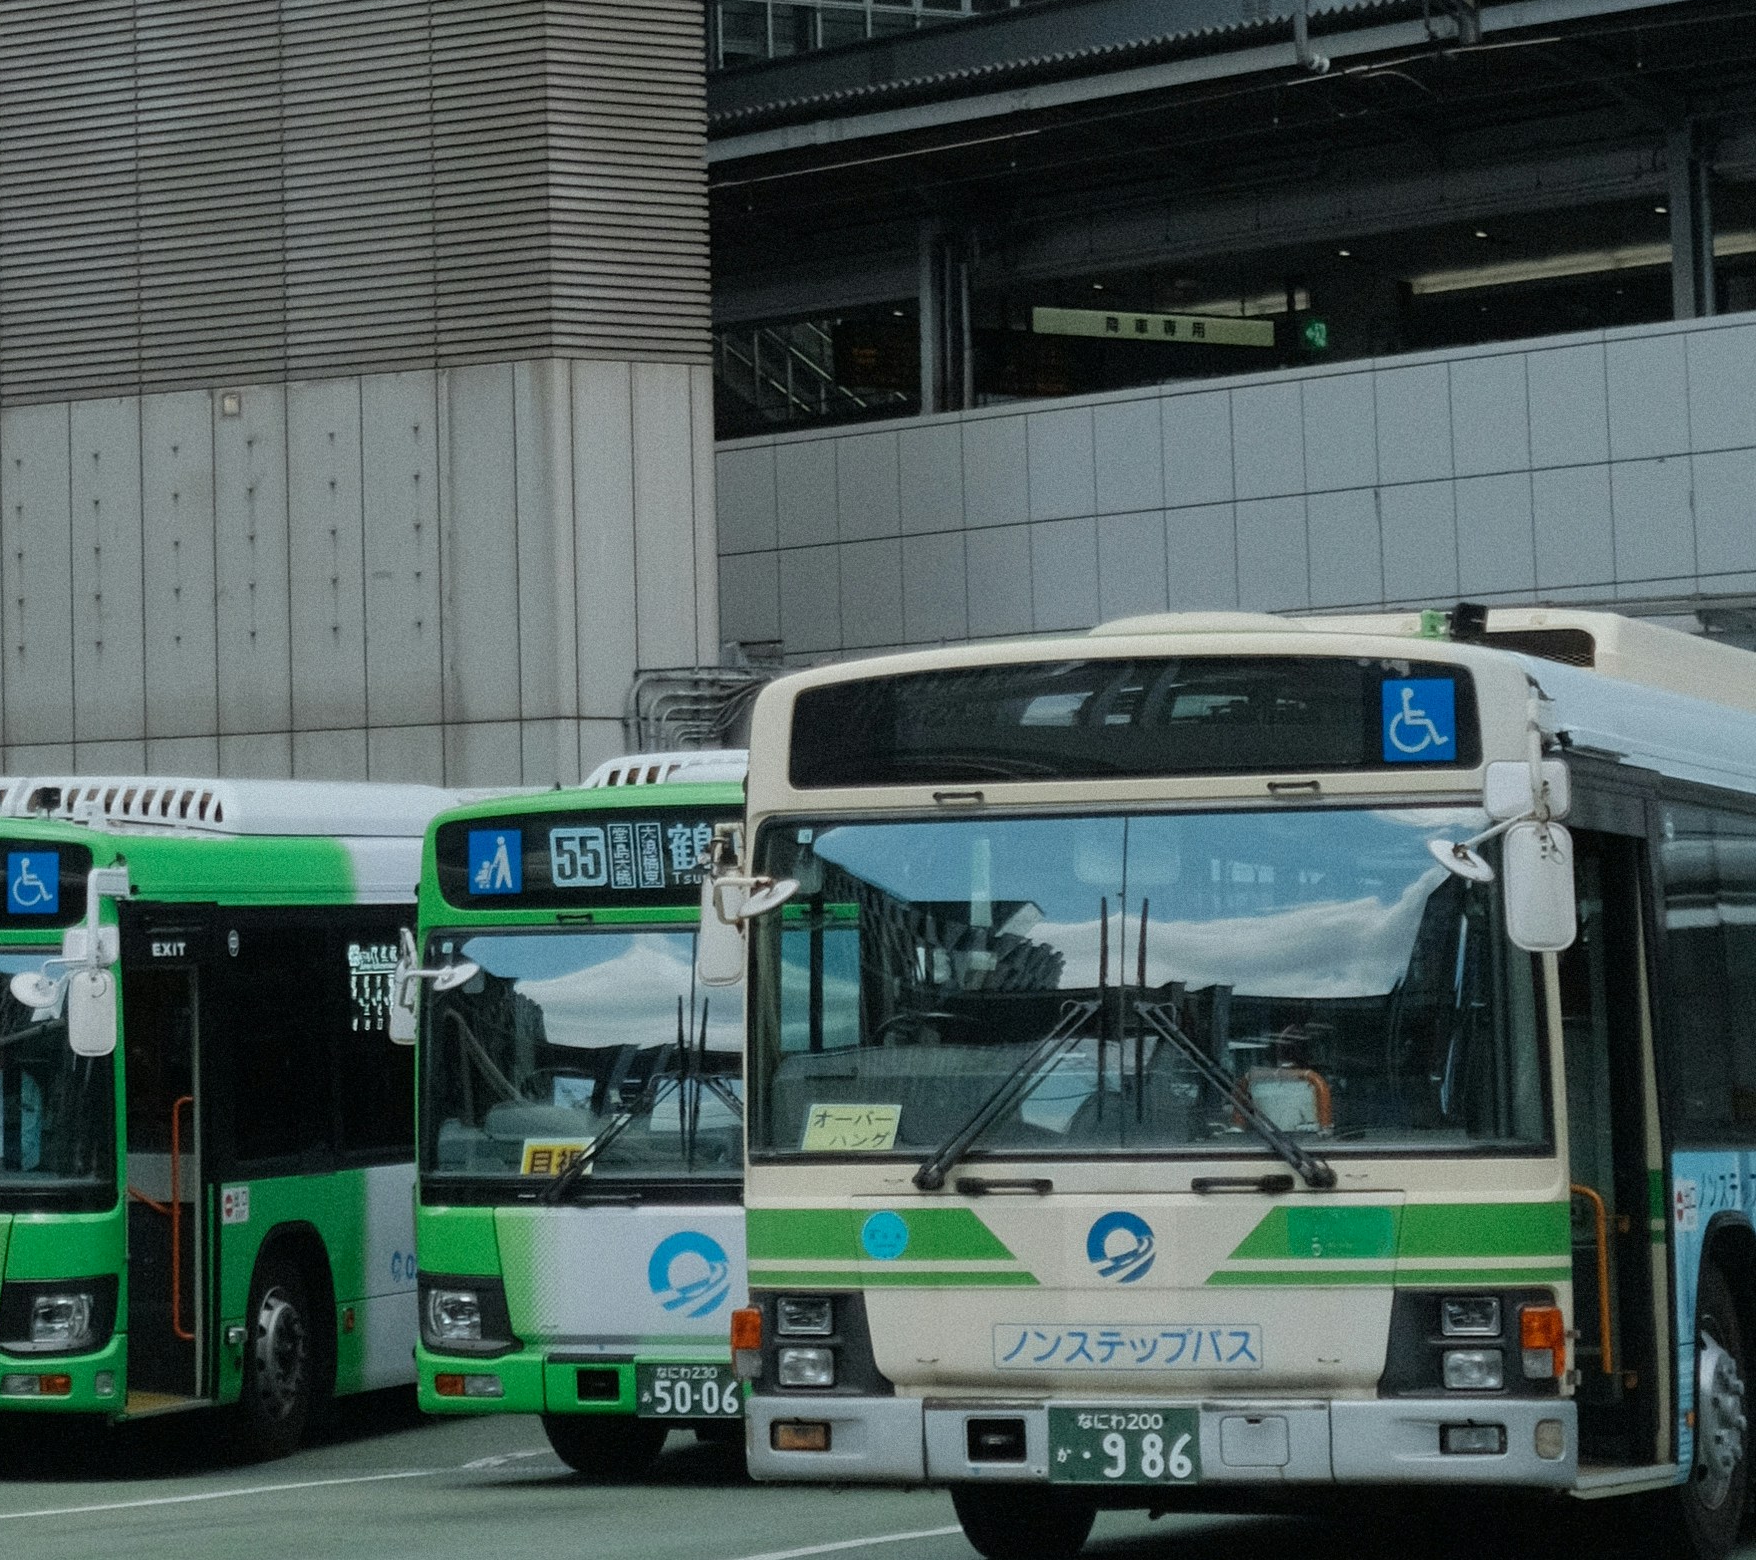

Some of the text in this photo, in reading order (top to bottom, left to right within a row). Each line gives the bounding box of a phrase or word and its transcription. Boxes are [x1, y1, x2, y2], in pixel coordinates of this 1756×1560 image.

[555, 836, 602, 880] 55
[151, 942, 186, 957] EXIT
[813, 1110, 894, 1129] オーバー
[829, 1130, 891, 1148] ハング
[1002, 1327, 1258, 1365] ノンステップバス
[1077, 1412, 1163, 1430] なにわ200
[1056, 1447, 1073, 1464] か
